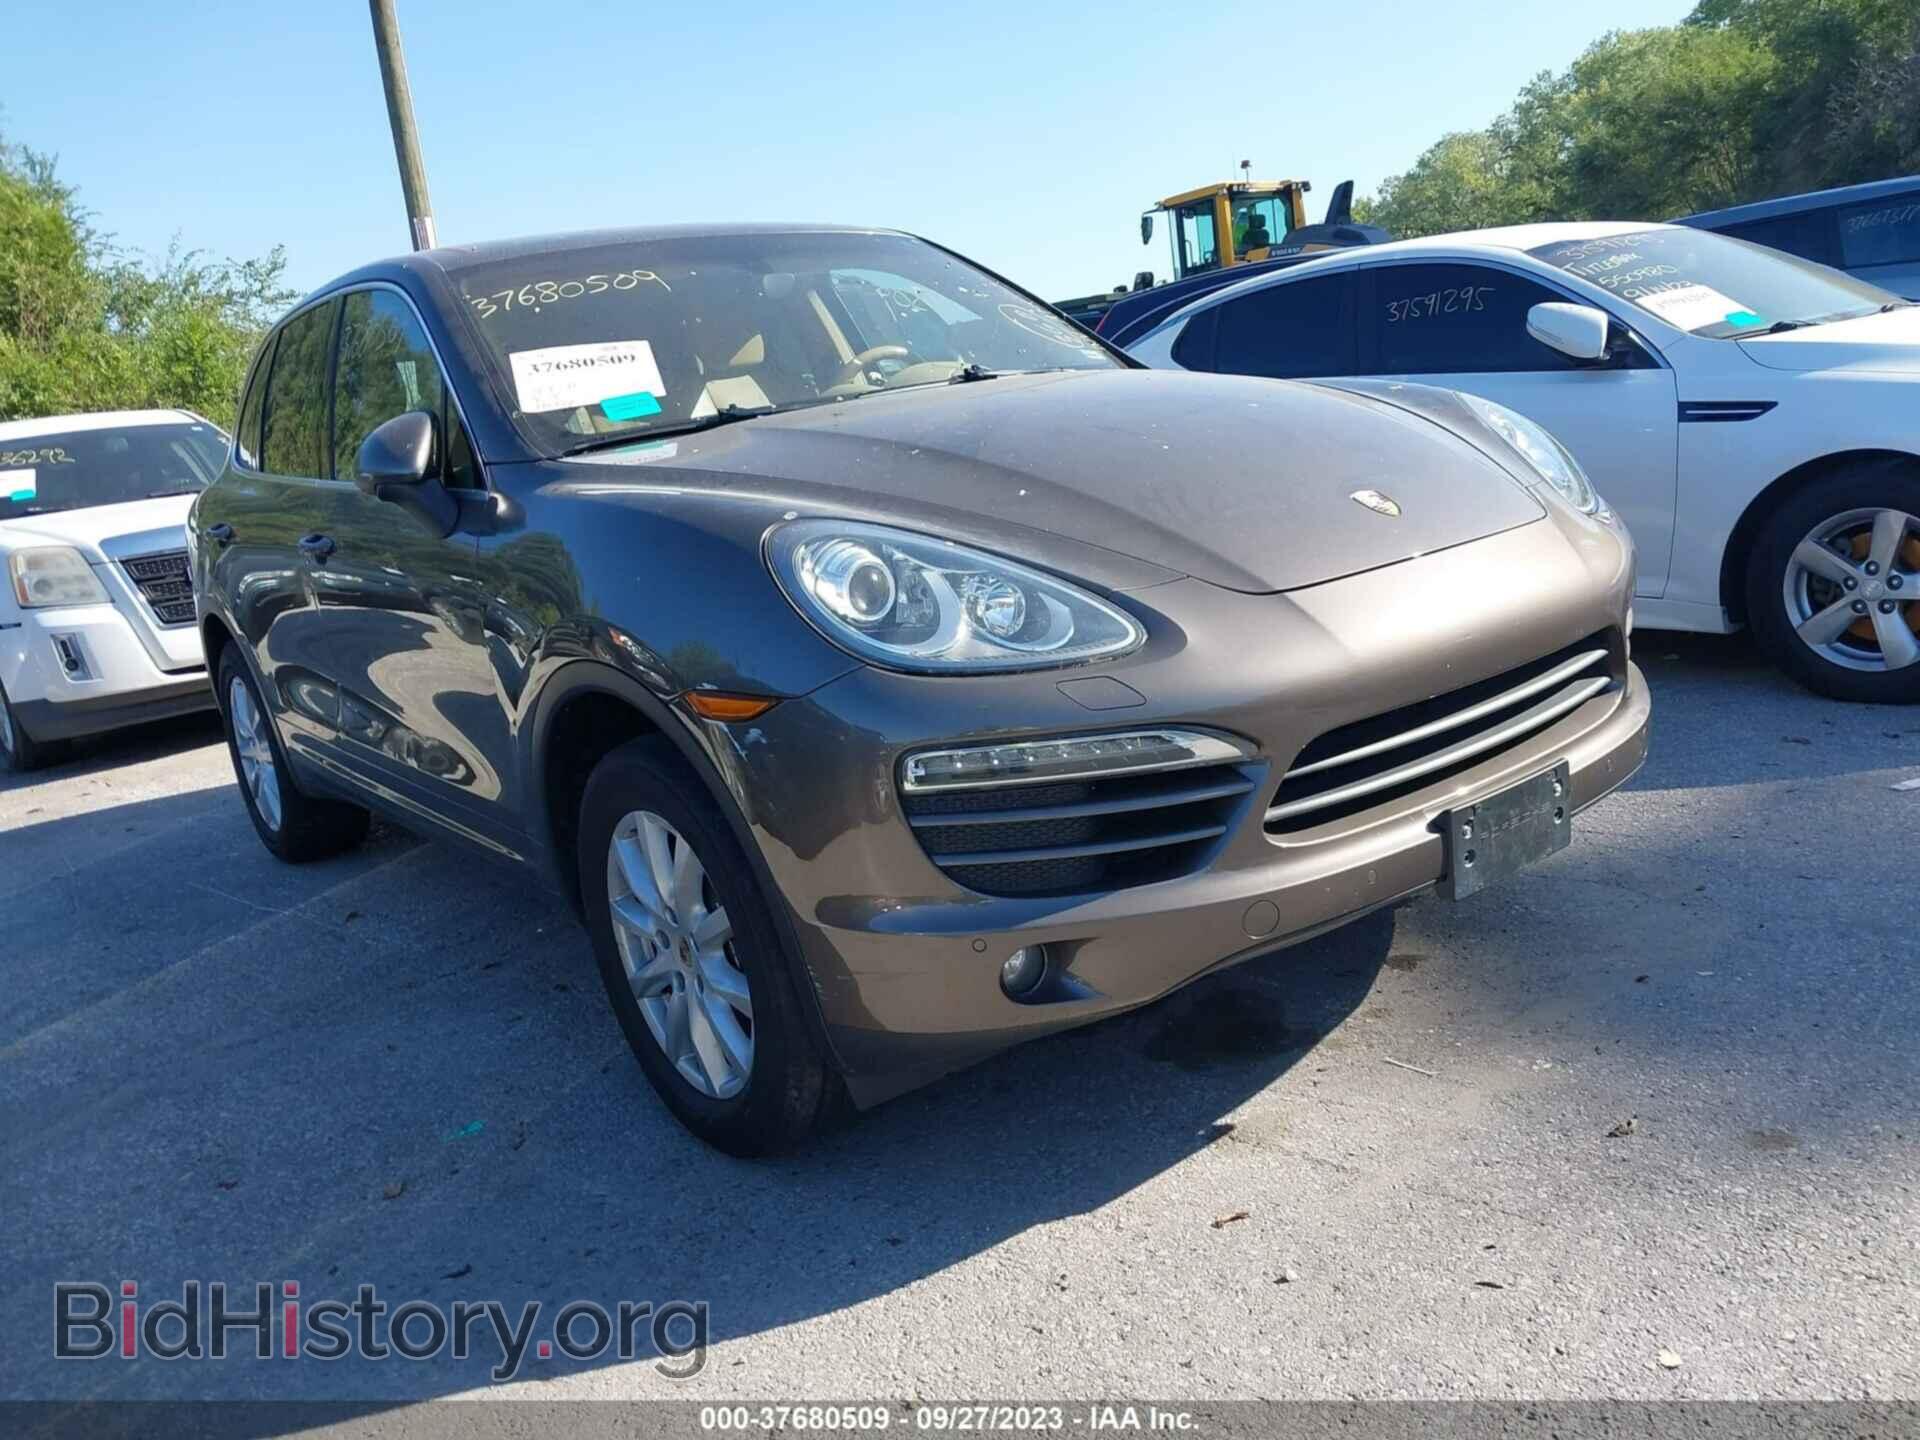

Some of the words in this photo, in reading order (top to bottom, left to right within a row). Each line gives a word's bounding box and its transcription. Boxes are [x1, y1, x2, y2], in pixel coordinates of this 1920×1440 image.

[471, 269, 673, 319] 37680509
[1386, 286, 1496, 322] 37591295
[529, 352, 637, 373] 37680509
